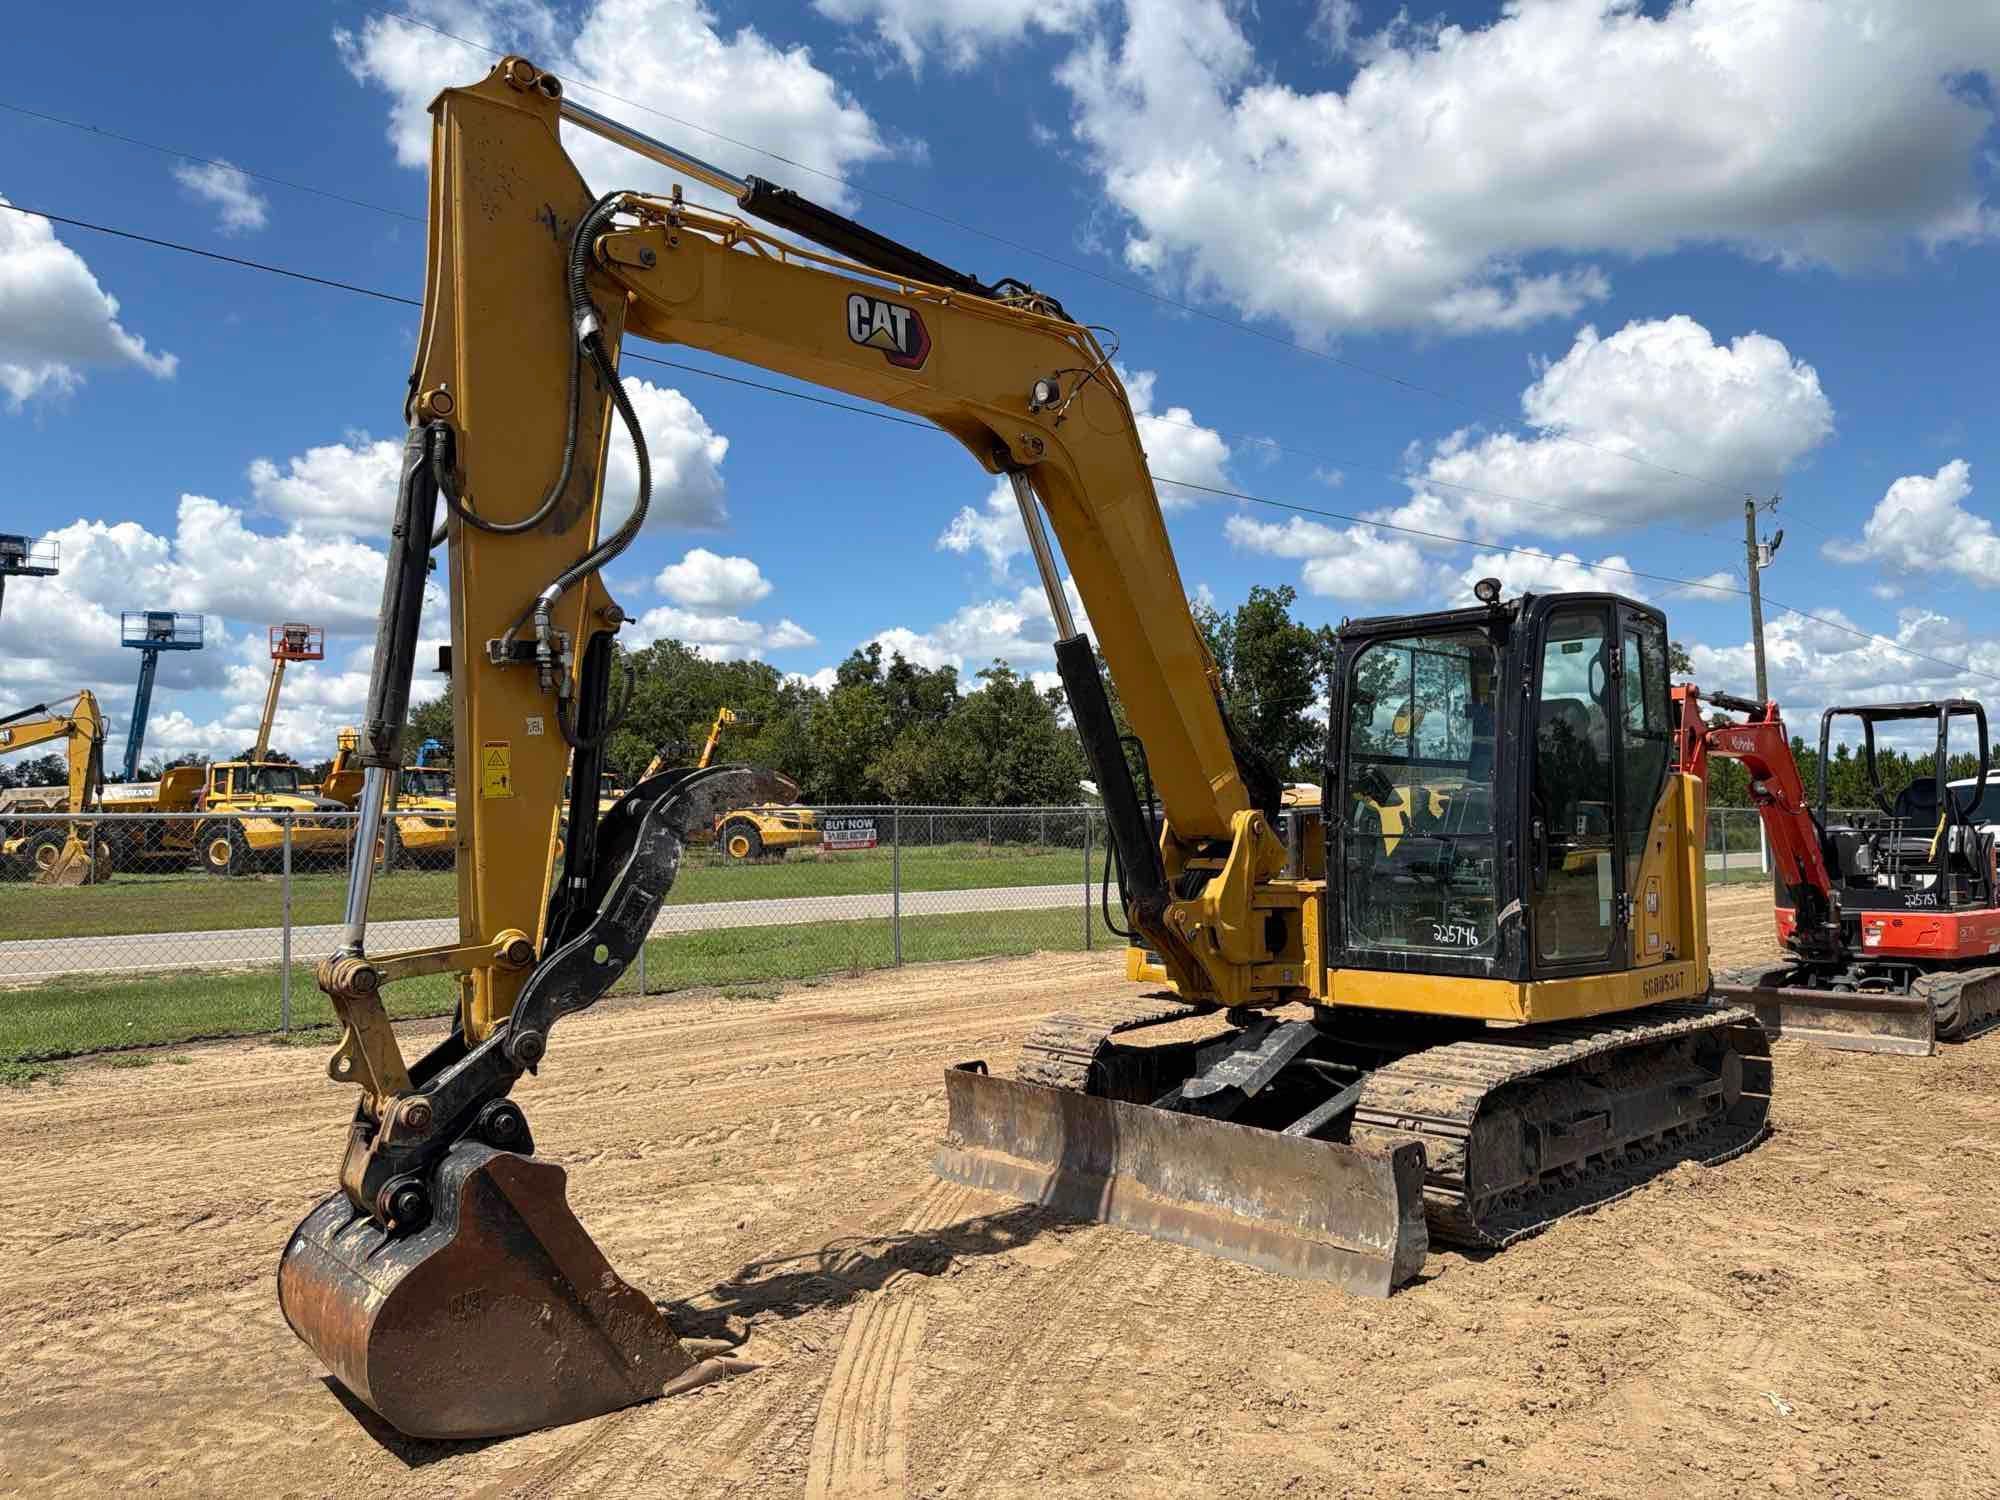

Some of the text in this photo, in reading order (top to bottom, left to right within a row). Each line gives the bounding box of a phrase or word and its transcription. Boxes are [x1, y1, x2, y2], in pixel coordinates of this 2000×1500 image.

[849, 295, 911, 352] CAT
[825, 818, 874, 830] BUY NOW
[1432, 924, 1478, 946] 225746
